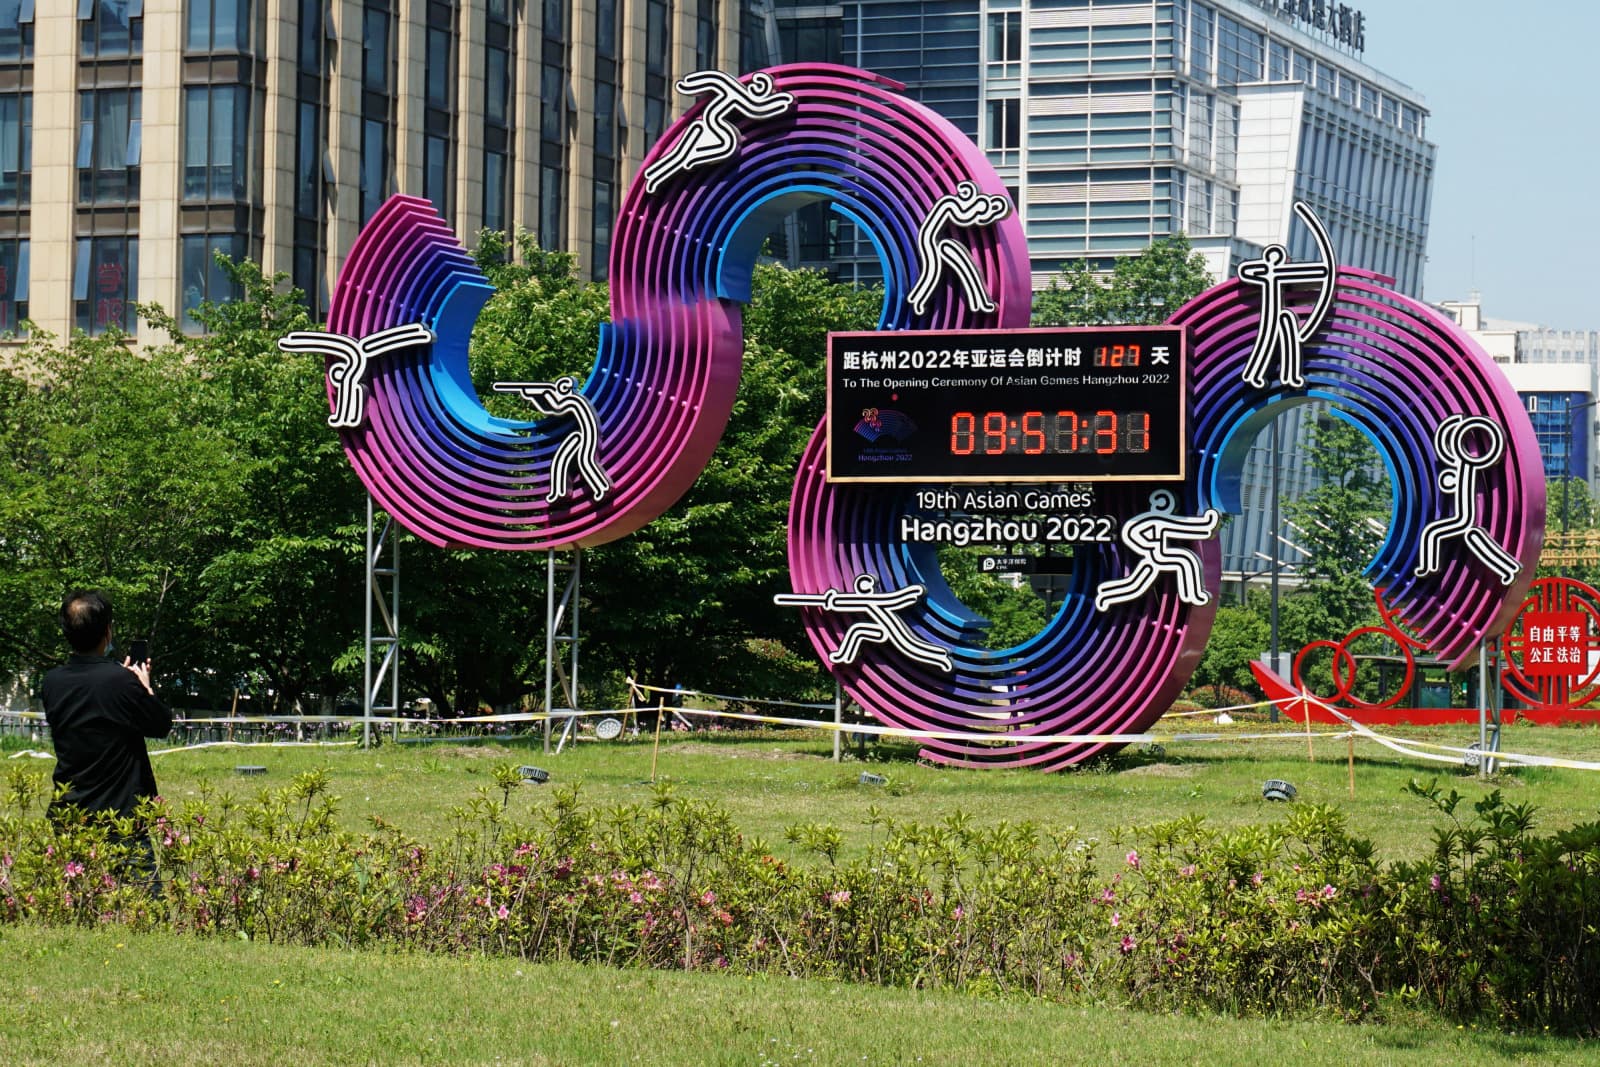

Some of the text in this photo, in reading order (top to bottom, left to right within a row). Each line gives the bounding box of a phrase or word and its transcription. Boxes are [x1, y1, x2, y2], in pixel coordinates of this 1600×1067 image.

[843, 346, 1082, 370] 距杭州2022年亚运会倒计时
[1150, 346, 1170, 365] 天
[843, 374, 1170, 390] To The Opening Ceremony Of Asian Games Hangzhou 2022
[951, 410, 1151, 456] 09:57:31
[916, 490, 1092, 510] 19th Asian Games
[901, 516, 1112, 546] Hangzhou 2022
[1529, 625, 1581, 643] 自由平等
[1529, 646, 1581, 664] 公正法治
